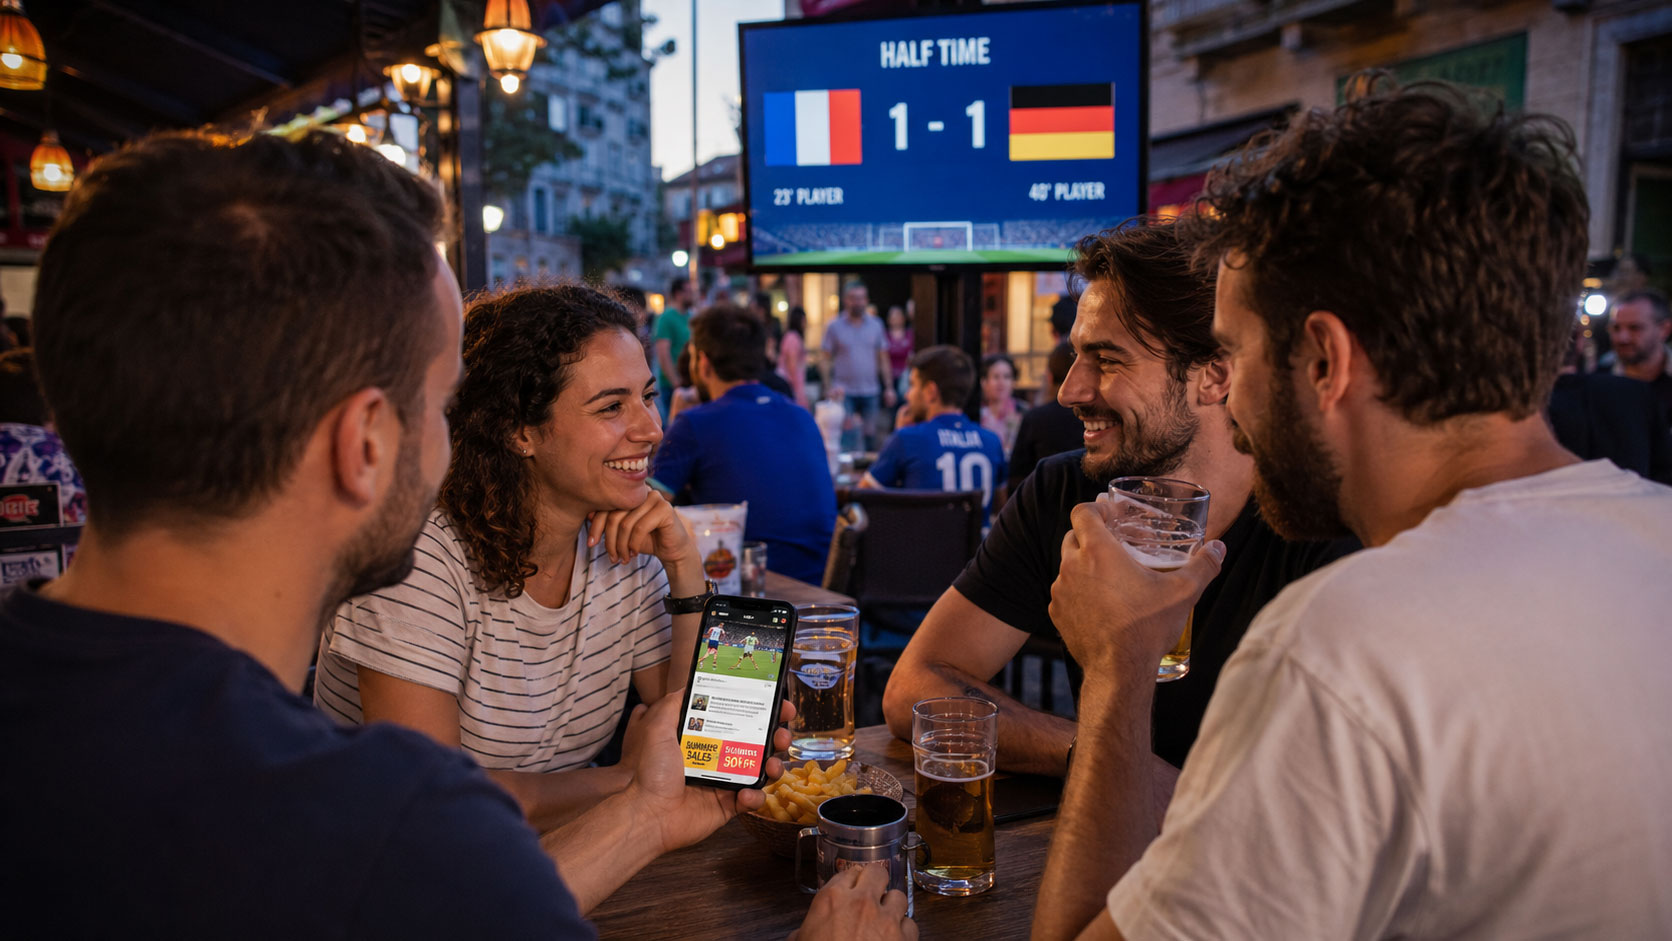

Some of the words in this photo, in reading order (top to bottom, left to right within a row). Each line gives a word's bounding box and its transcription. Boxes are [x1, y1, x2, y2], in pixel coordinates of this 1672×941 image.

[880, 39, 934, 68] HALF
[937, 37, 991, 66] TIME
[888, 102, 908, 151] 1
[966, 100, 986, 149] 1
[796, 187, 844, 206] PLAYER
[1054, 182, 1106, 201] PLAYER
[936, 451, 993, 508] 10
